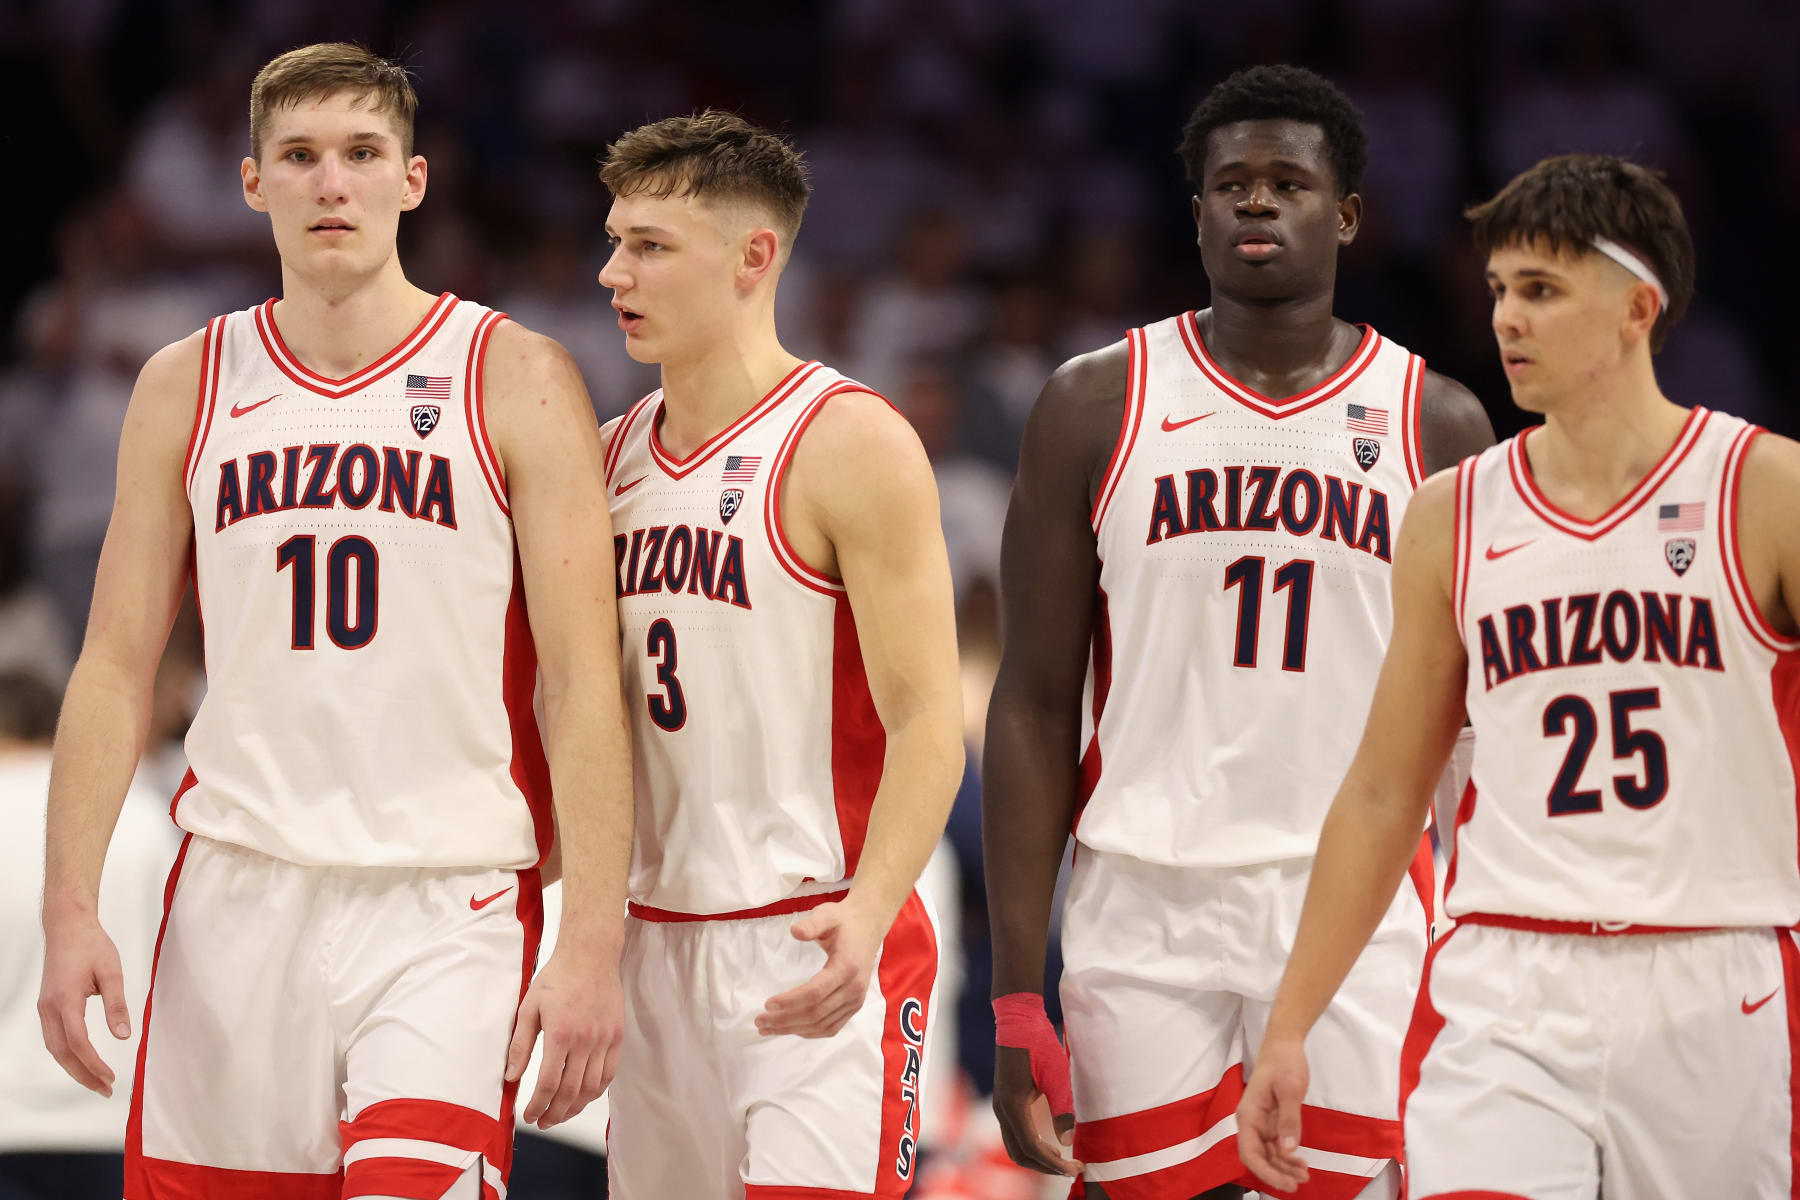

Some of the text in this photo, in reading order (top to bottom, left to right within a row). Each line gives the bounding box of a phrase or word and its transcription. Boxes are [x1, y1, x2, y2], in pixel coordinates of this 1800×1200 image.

[412, 406, 439, 425] PAC
[416, 418, 432, 431] 12
[1355, 439, 1379, 459] PAC
[1360, 451, 1373, 464] 12
[215, 443, 458, 534] ARIZONA
[721, 490, 743, 511] PAC
[722, 502, 735, 517] 12
[1146, 466, 1392, 565] ARIZONA
[276, 534, 380, 651] 10
[614, 524, 753, 610] RIZONA
[1223, 555, 1315, 673] 11
[1477, 589, 1726, 693] ARIZONA
[647, 617, 687, 733] 3
[1542, 687, 1670, 818] 25
[896, 997, 923, 1181] CATS
